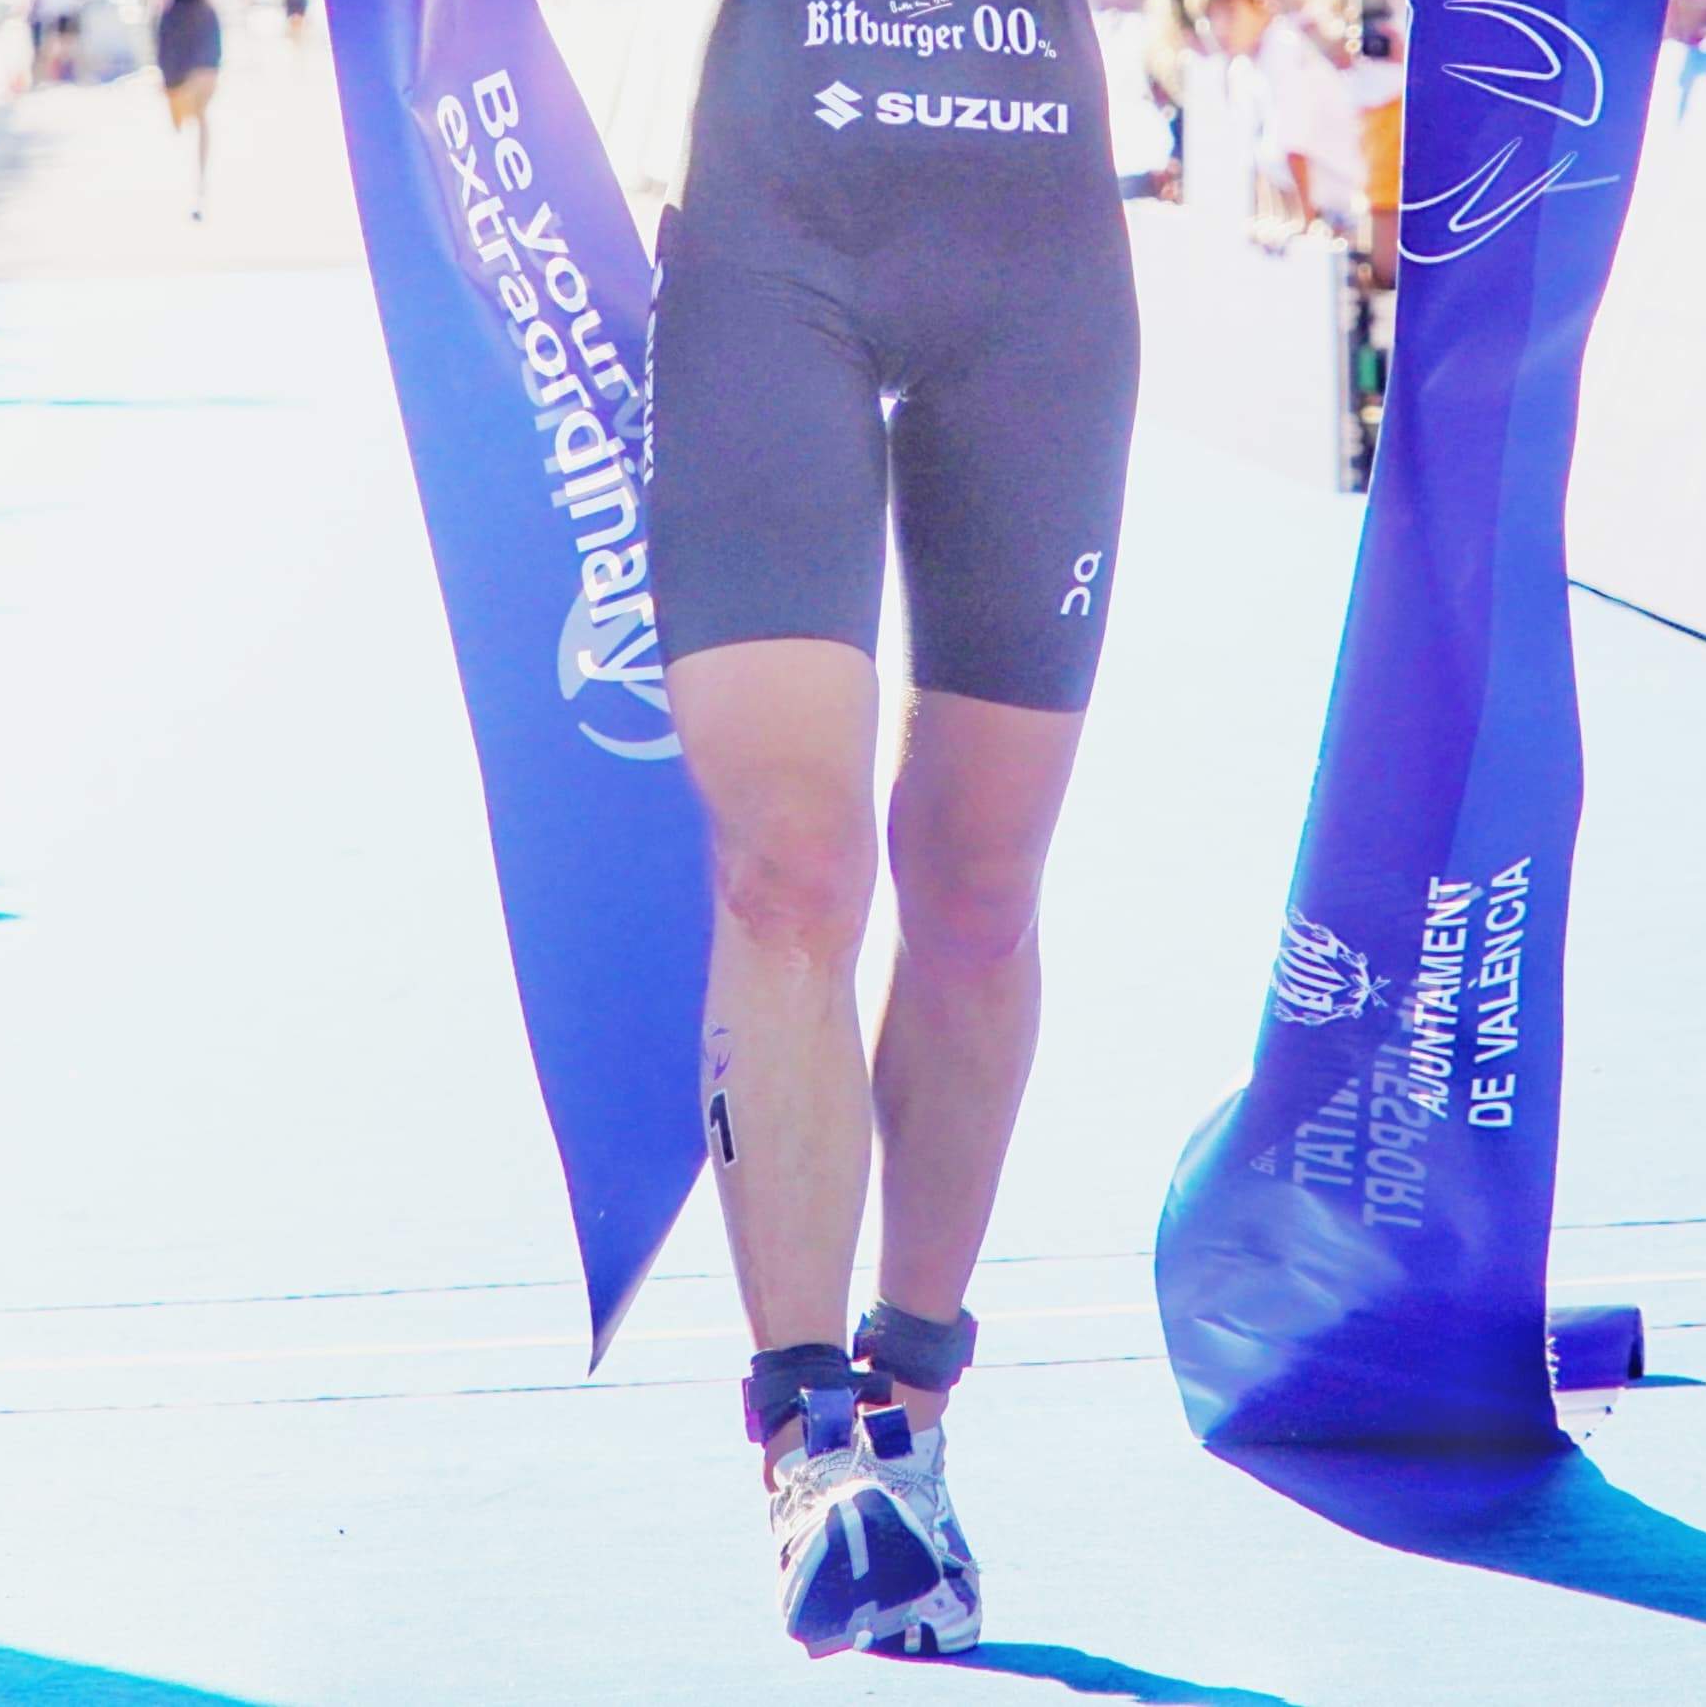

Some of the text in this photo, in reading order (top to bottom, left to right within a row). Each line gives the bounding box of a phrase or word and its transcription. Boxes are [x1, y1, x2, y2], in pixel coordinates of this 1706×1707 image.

[804, 0, 965, 58] Bitburger
[876, 92, 1069, 135] SUZUKI
[471, 68, 638, 397] Be your
[436, 94, 665, 683] extraordinary
[1407, 876, 1473, 1119] AJUNTAMENT
[1468, 856, 1532, 1129] DE VALÈNCIA
